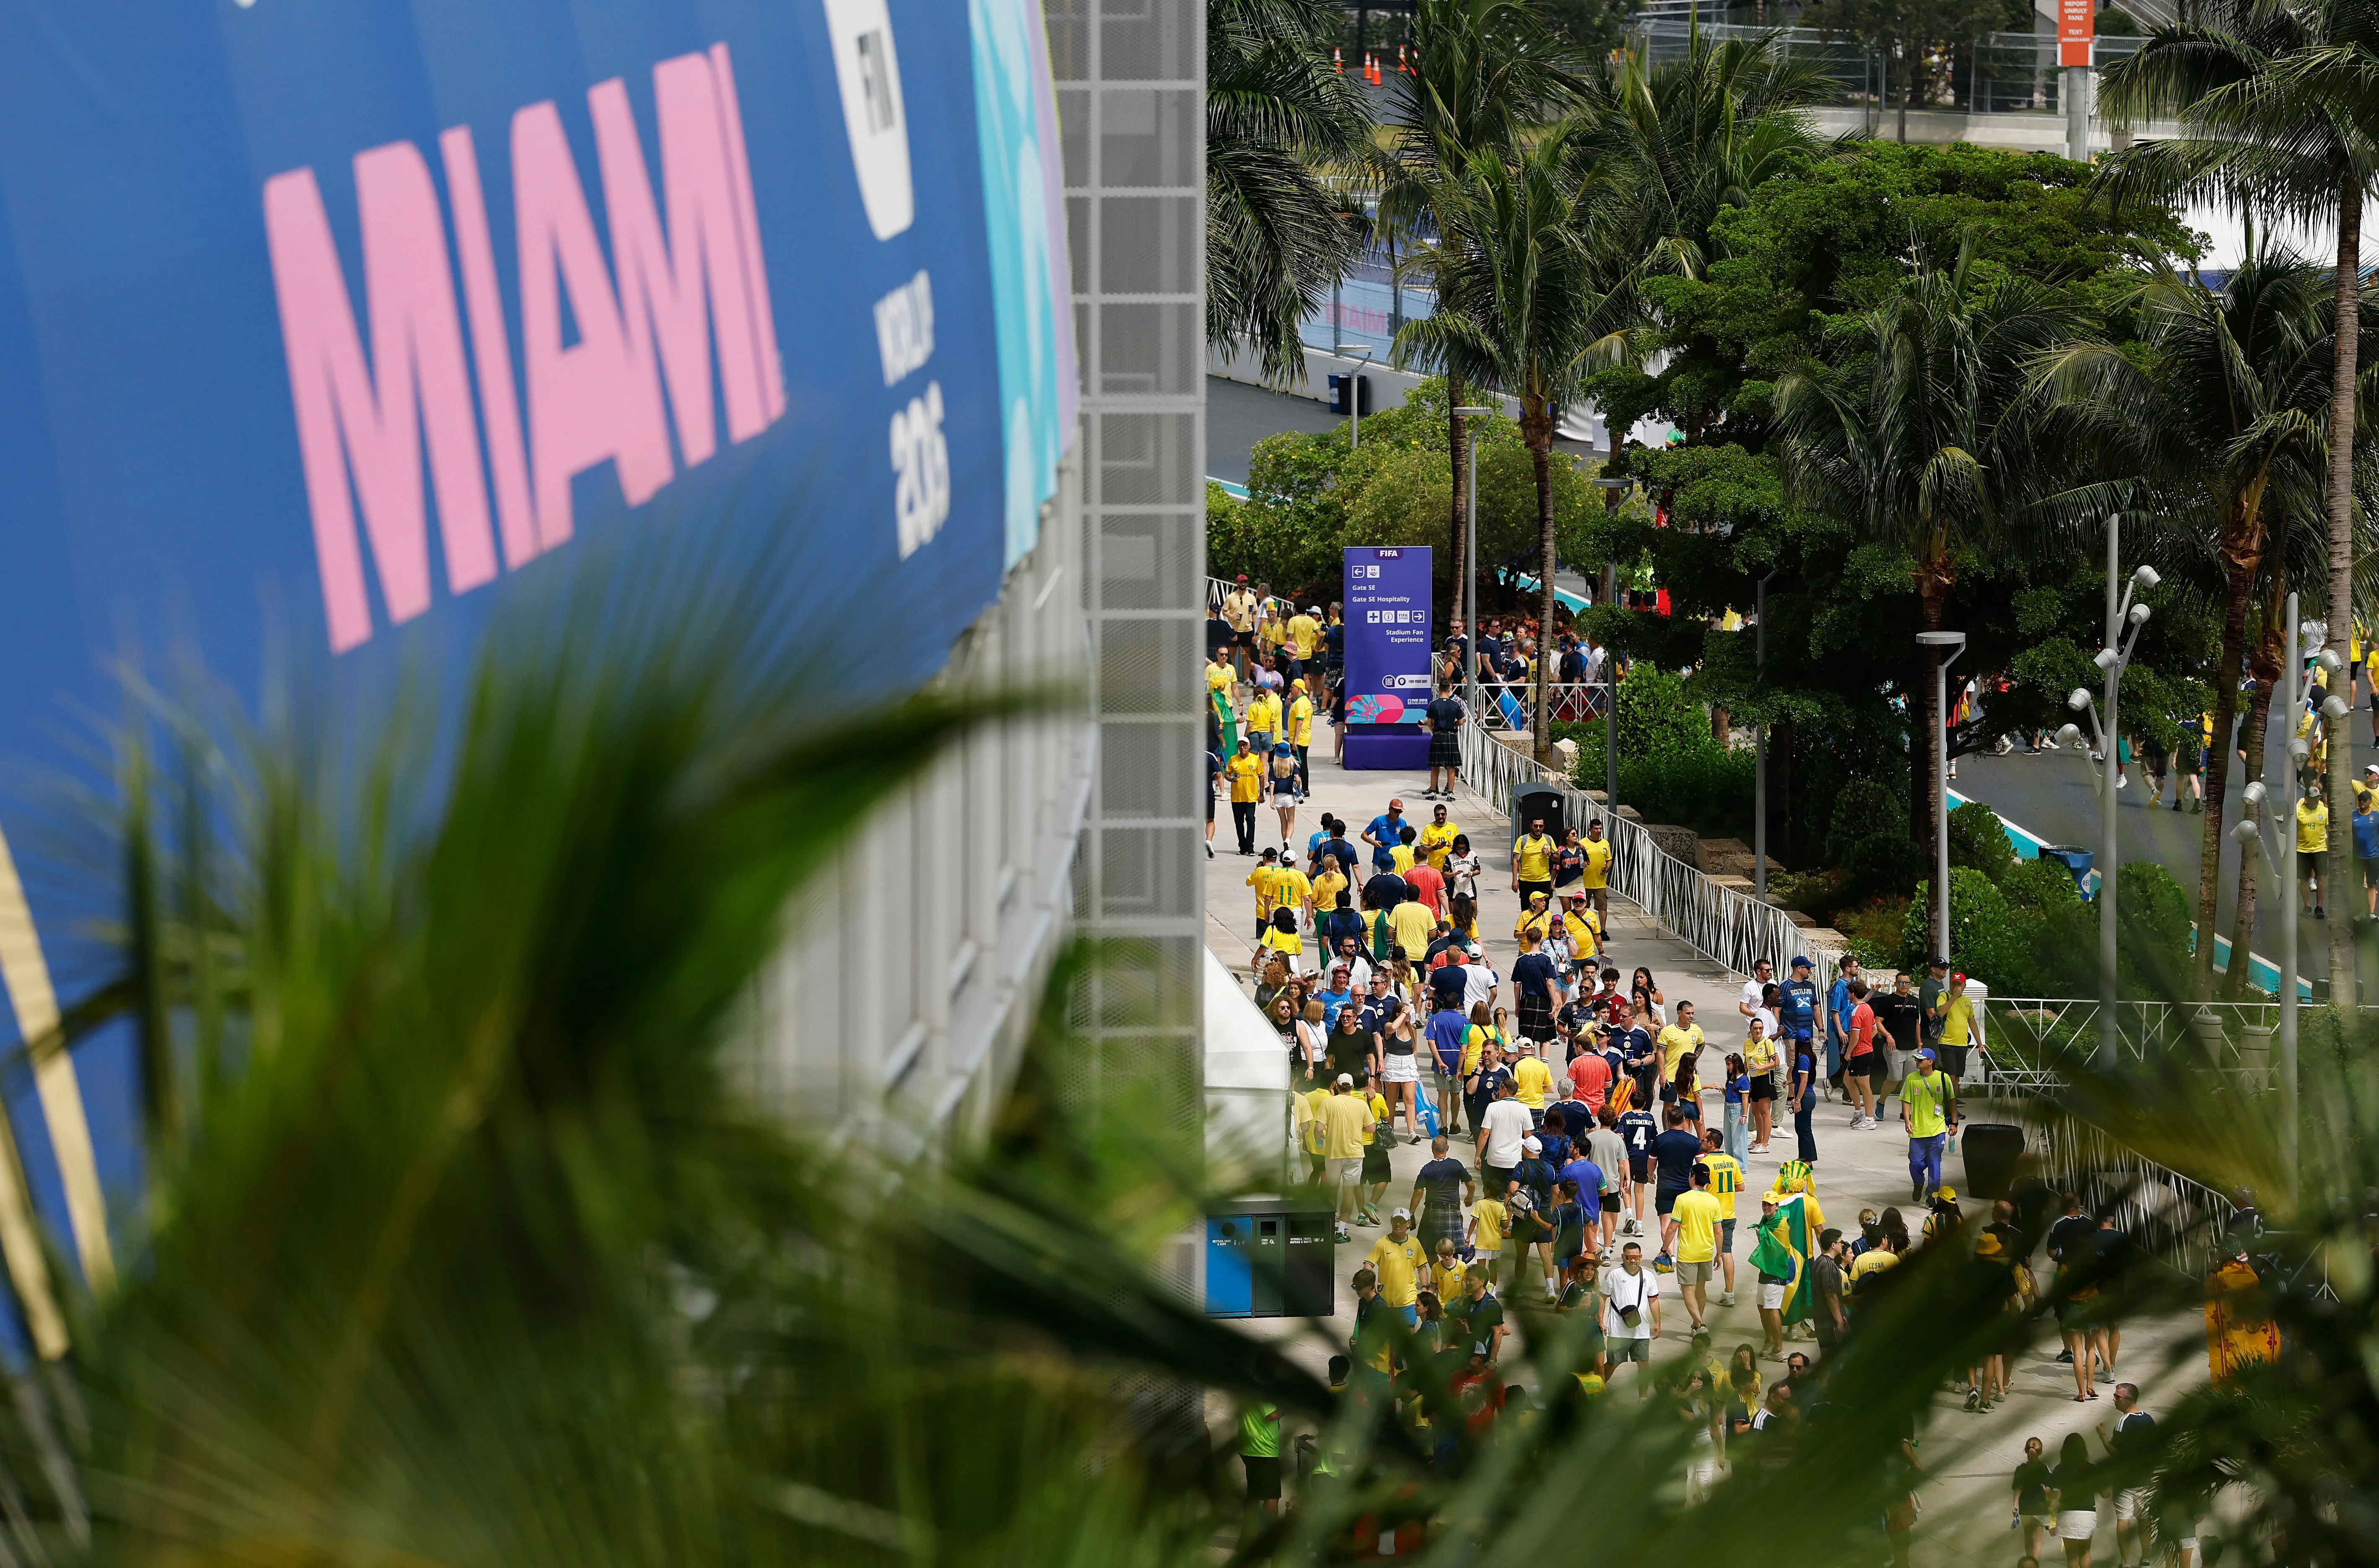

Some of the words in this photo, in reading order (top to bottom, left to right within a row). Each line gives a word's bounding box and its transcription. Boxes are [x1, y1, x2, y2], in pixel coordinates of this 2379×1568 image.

[264, 42, 786, 656] MIAMI
[1561, 857, 1579, 867] COLOM
[1280, 885, 1292, 905] 11
[1331, 1001, 1349, 1009] SCOTLA
[1633, 1126, 1647, 1150] 4
[1716, 1170, 1734, 1194] 11
